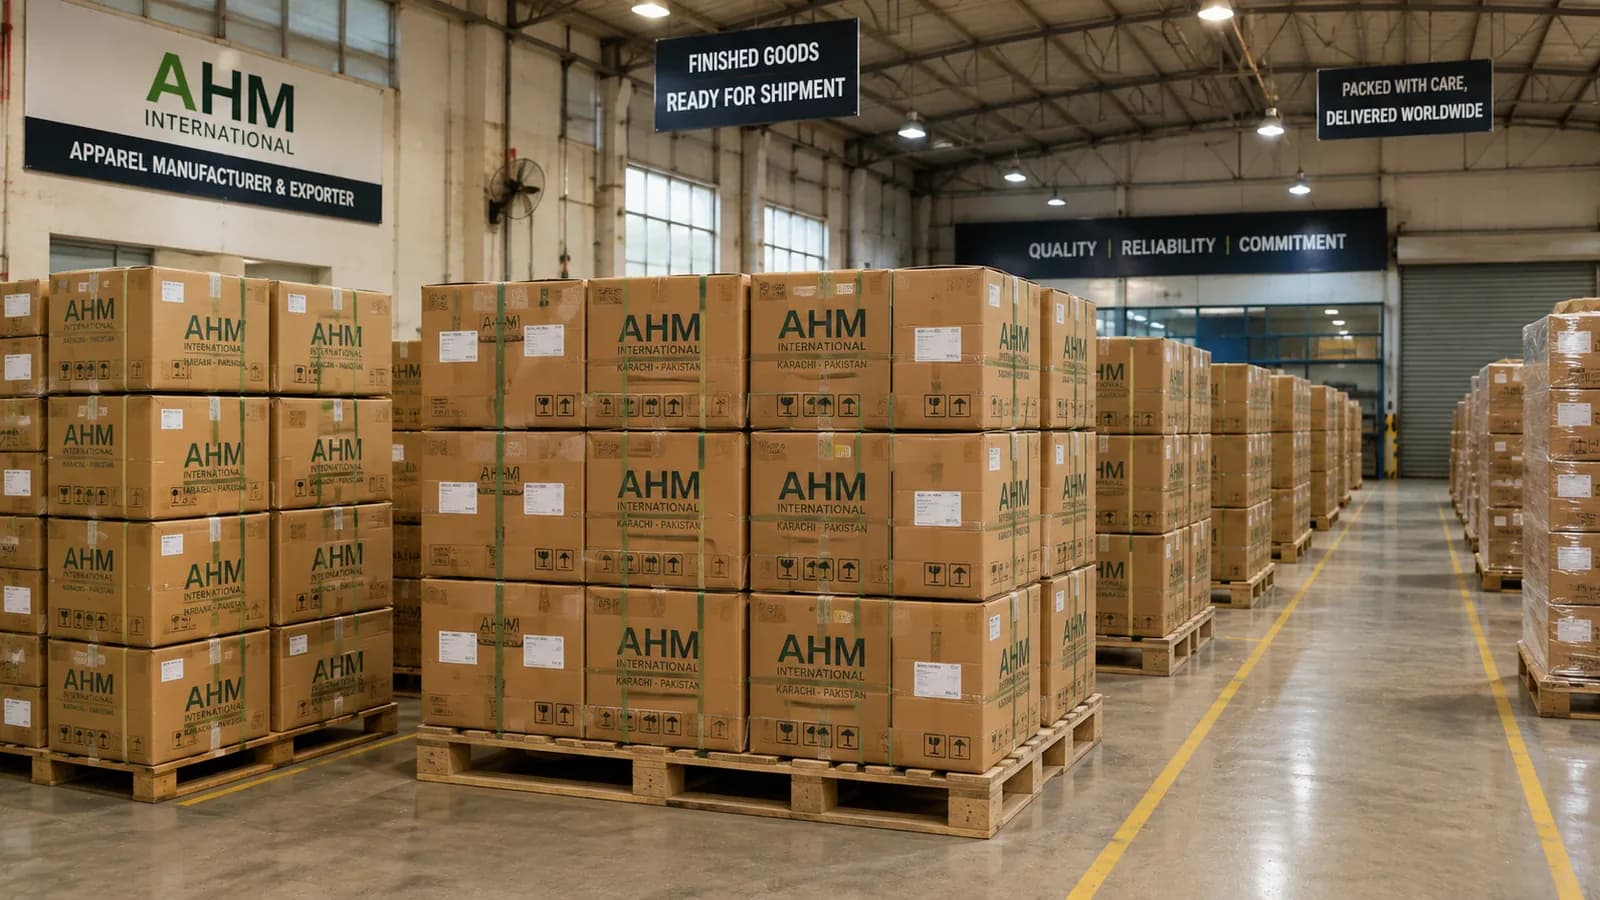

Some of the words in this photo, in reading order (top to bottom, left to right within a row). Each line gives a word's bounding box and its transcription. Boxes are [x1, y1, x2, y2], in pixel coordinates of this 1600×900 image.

[689, 48, 759, 73] FINISHED
[764, 42, 819, 66] GOODS
[146, 52, 294, 133] AHM
[667, 88, 719, 112] READY
[725, 86, 756, 106] FOR
[760, 77, 846, 104] SHIPMENT
[1342, 80, 1391, 96] PACKED
[1395, 78, 1426, 94] WITH
[1431, 76, 1468, 92] CARE,
[1326, 108, 1397, 126] DELIVERED
[1401, 102, 1484, 122] WORLDWIDE
[145, 109, 294, 155] INTERNATIONAL
[70, 141, 148, 172] APPAREL
[153, 155, 272, 193] MANUFACTURER
[276, 178, 286, 196] &
[290, 181, 354, 207] EXPORTER
[1028, 241, 1097, 260] QUALITY
[1122, 237, 1216, 255] RELIABILITY
[1239, 233, 1346, 252] COMMITMENT
[64, 298, 114, 322] AHM
[778, 308, 866, 338] AHM
[184, 314, 245, 342] AHM
[311, 322, 362, 348] AHM
[618, 313, 700, 342] AHM
[1000, 322, 1029, 352] AHM
[618, 344, 700, 355] INTERNATIONAL
[778, 342, 866, 352] INTERNATIONAL
[617, 362, 653, 372] KARACHI
[662, 362, 700, 372] PAKISTAN
[777, 360, 816, 369] KARACHI
[824, 360, 867, 370] PAKISTAN
[1096, 363, 1124, 380] HM
[64, 424, 113, 446] AHM
[184, 442, 244, 468] AHM
[311, 438, 362, 462] AHM
[1096, 460, 1124, 479] HM
[618, 470, 700, 499] AHM
[778, 472, 866, 500] AHM
[1000, 480, 1029, 512] AHM
[618, 502, 699, 512] INTERNATIONAL
[778, 504, 866, 514] INTERNATIONAL
[617, 520, 652, 528] KARACHI
[661, 520, 700, 530] PAKISTAN
[777, 521, 816, 532] KARACHI
[824, 523, 868, 534] PAKISTAN
[64, 547, 113, 572] AHM
[312, 542, 363, 572] AHM
[1096, 560, 1124, 579] HM
[184, 560, 244, 590] AHM
[617, 627, 698, 660] AHM
[778, 634, 865, 668] AHM
[312, 651, 364, 683] AHM
[616, 659, 698, 672] INTERNATIONAL
[1000, 637, 1030, 680] AHM
[64, 668, 114, 694] AHM
[660, 680, 700, 690] PAKISTAN
[777, 666, 864, 682] INTERNATIONAL
[185, 676, 244, 712] AHM
[776, 684, 816, 696] KARACHI
[824, 688, 866, 699] PAKISTAN
